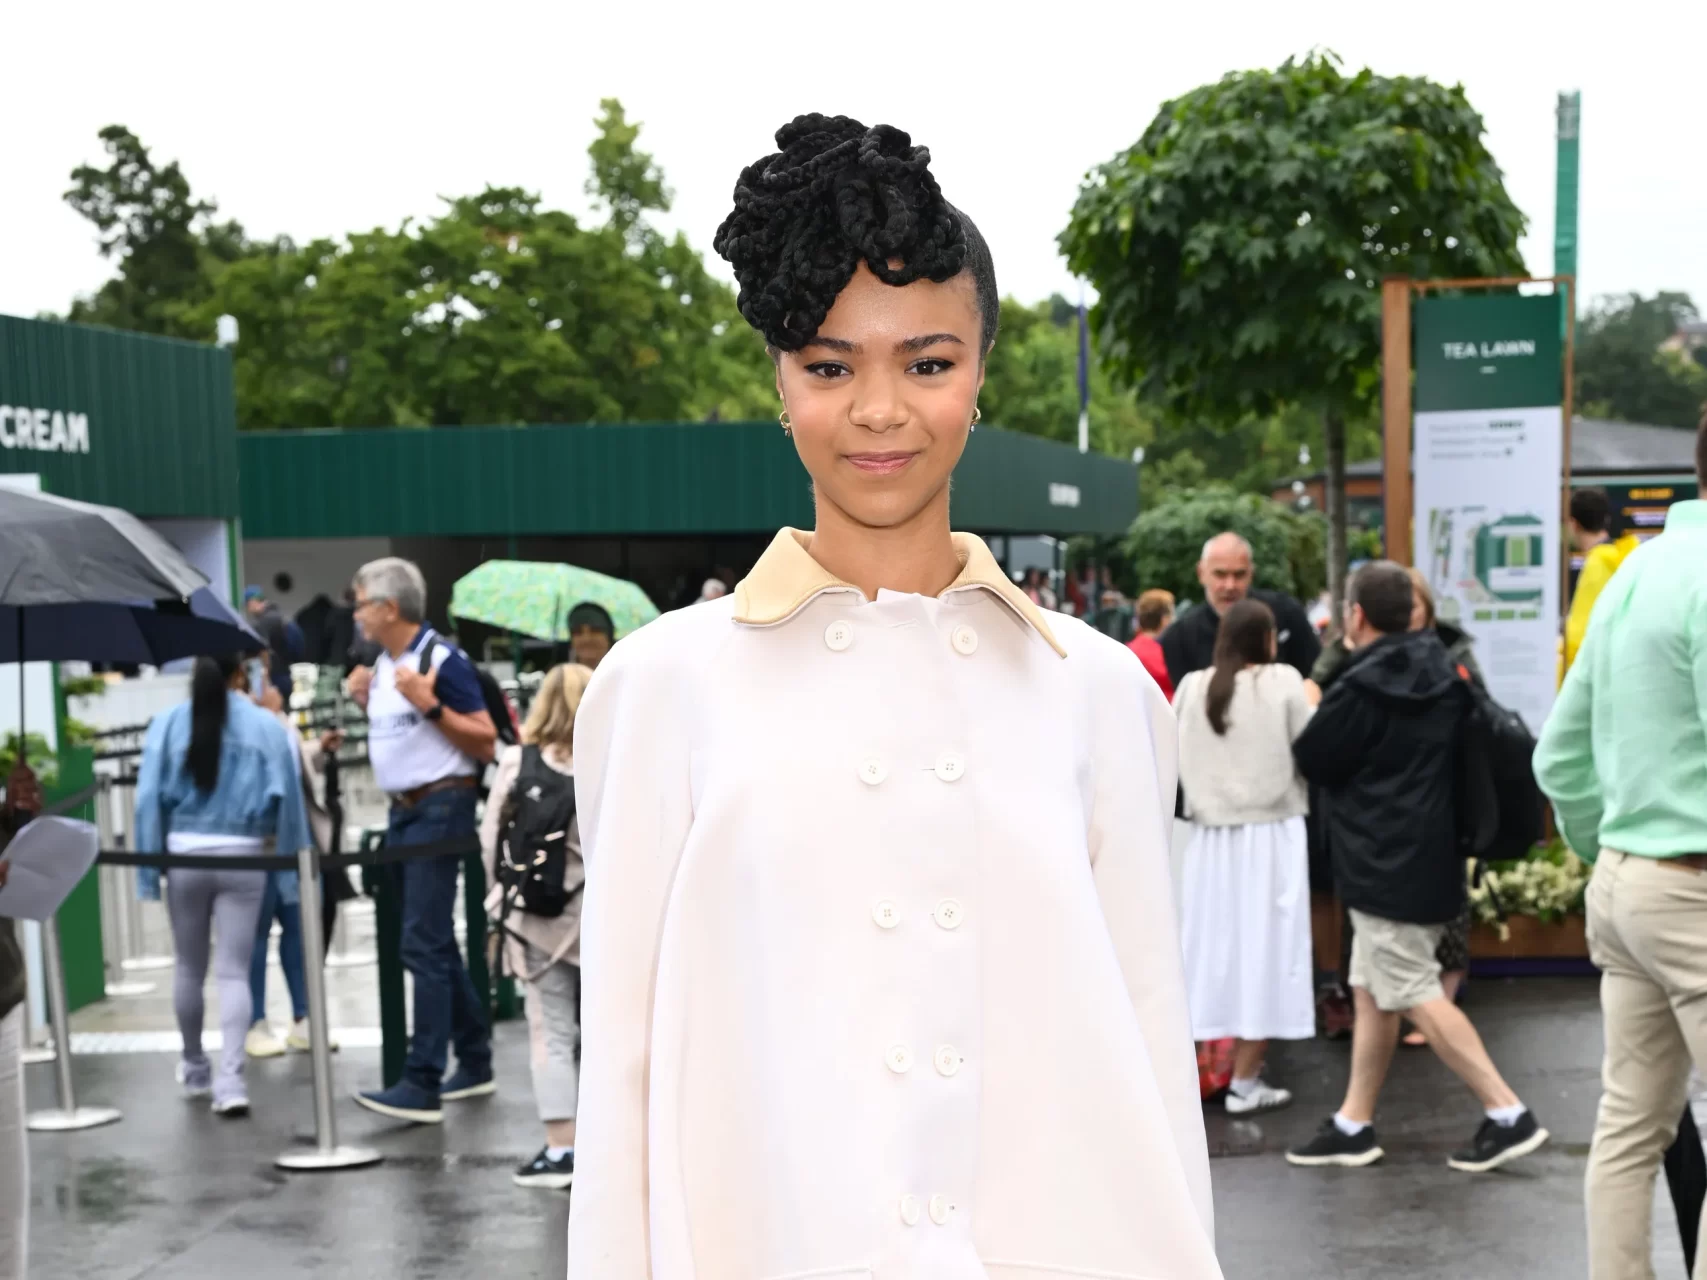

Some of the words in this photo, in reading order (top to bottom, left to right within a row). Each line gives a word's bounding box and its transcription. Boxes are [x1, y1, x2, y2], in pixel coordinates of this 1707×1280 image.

[1442, 341, 1478, 360] TEA
[1480, 339, 1536, 358] LAWN
[0, 404, 90, 454] CREAM
